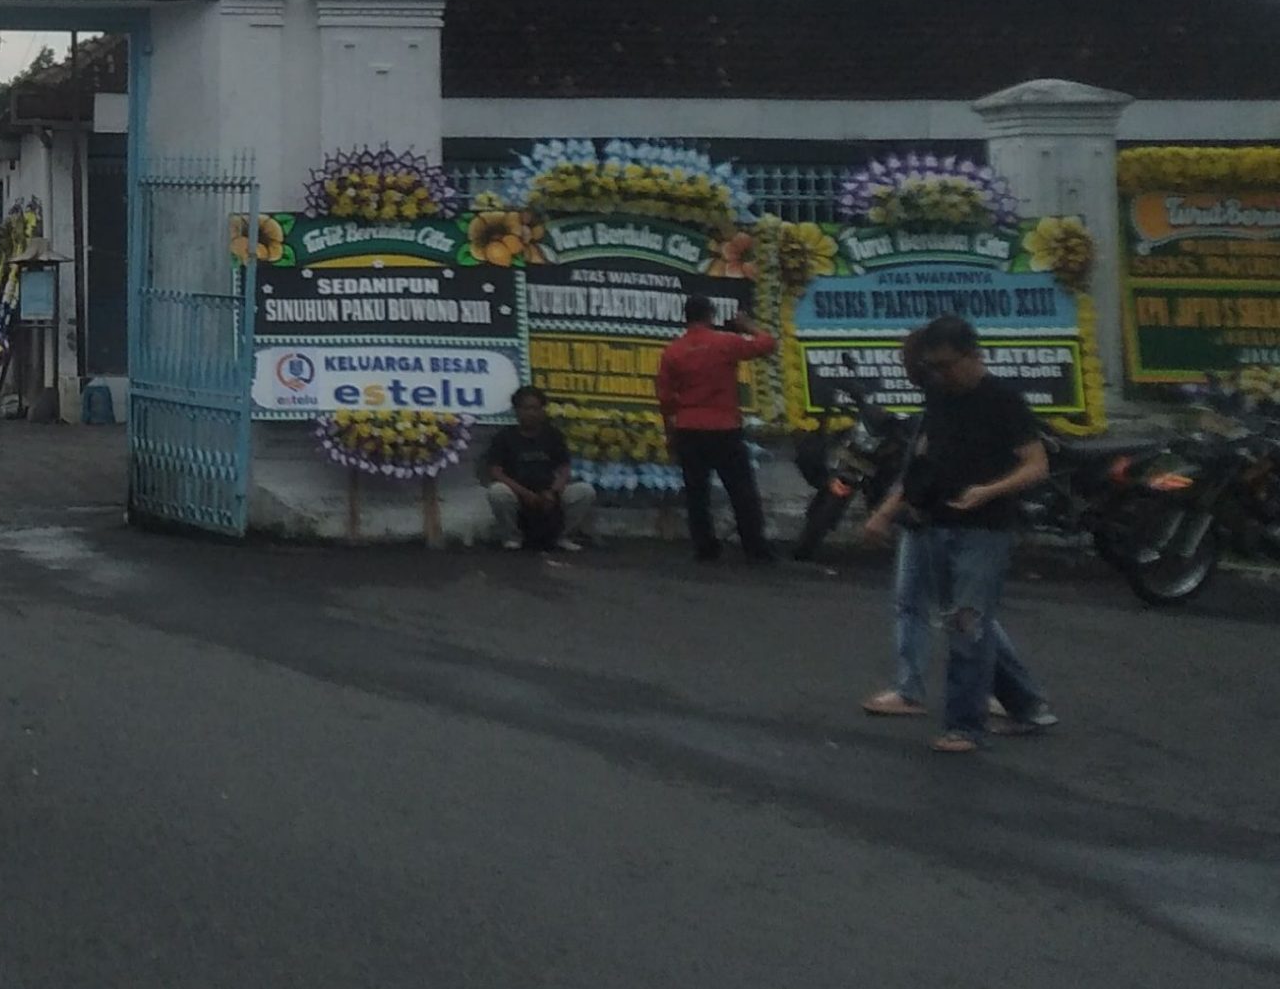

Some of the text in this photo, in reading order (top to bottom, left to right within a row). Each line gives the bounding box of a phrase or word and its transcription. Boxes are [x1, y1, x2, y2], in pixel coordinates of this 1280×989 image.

[317, 278, 440, 295] SEDANIPUN
[572, 269, 682, 289] ATAS WAFATNYA
[879, 271, 993, 285] ATAS WAFATNYA
[265, 298, 339, 322] SINUHUN
[341, 298, 386, 322] PAKU
[388, 299, 459, 323] BUWONO
[872, 289, 1012, 319] PAKUBUWONO
[1015, 287, 1057, 318] XIII
[324, 356, 489, 373] KELUARGA BESAR
[278, 394, 318, 405] estelu
[334, 379, 483, 407] estelu
